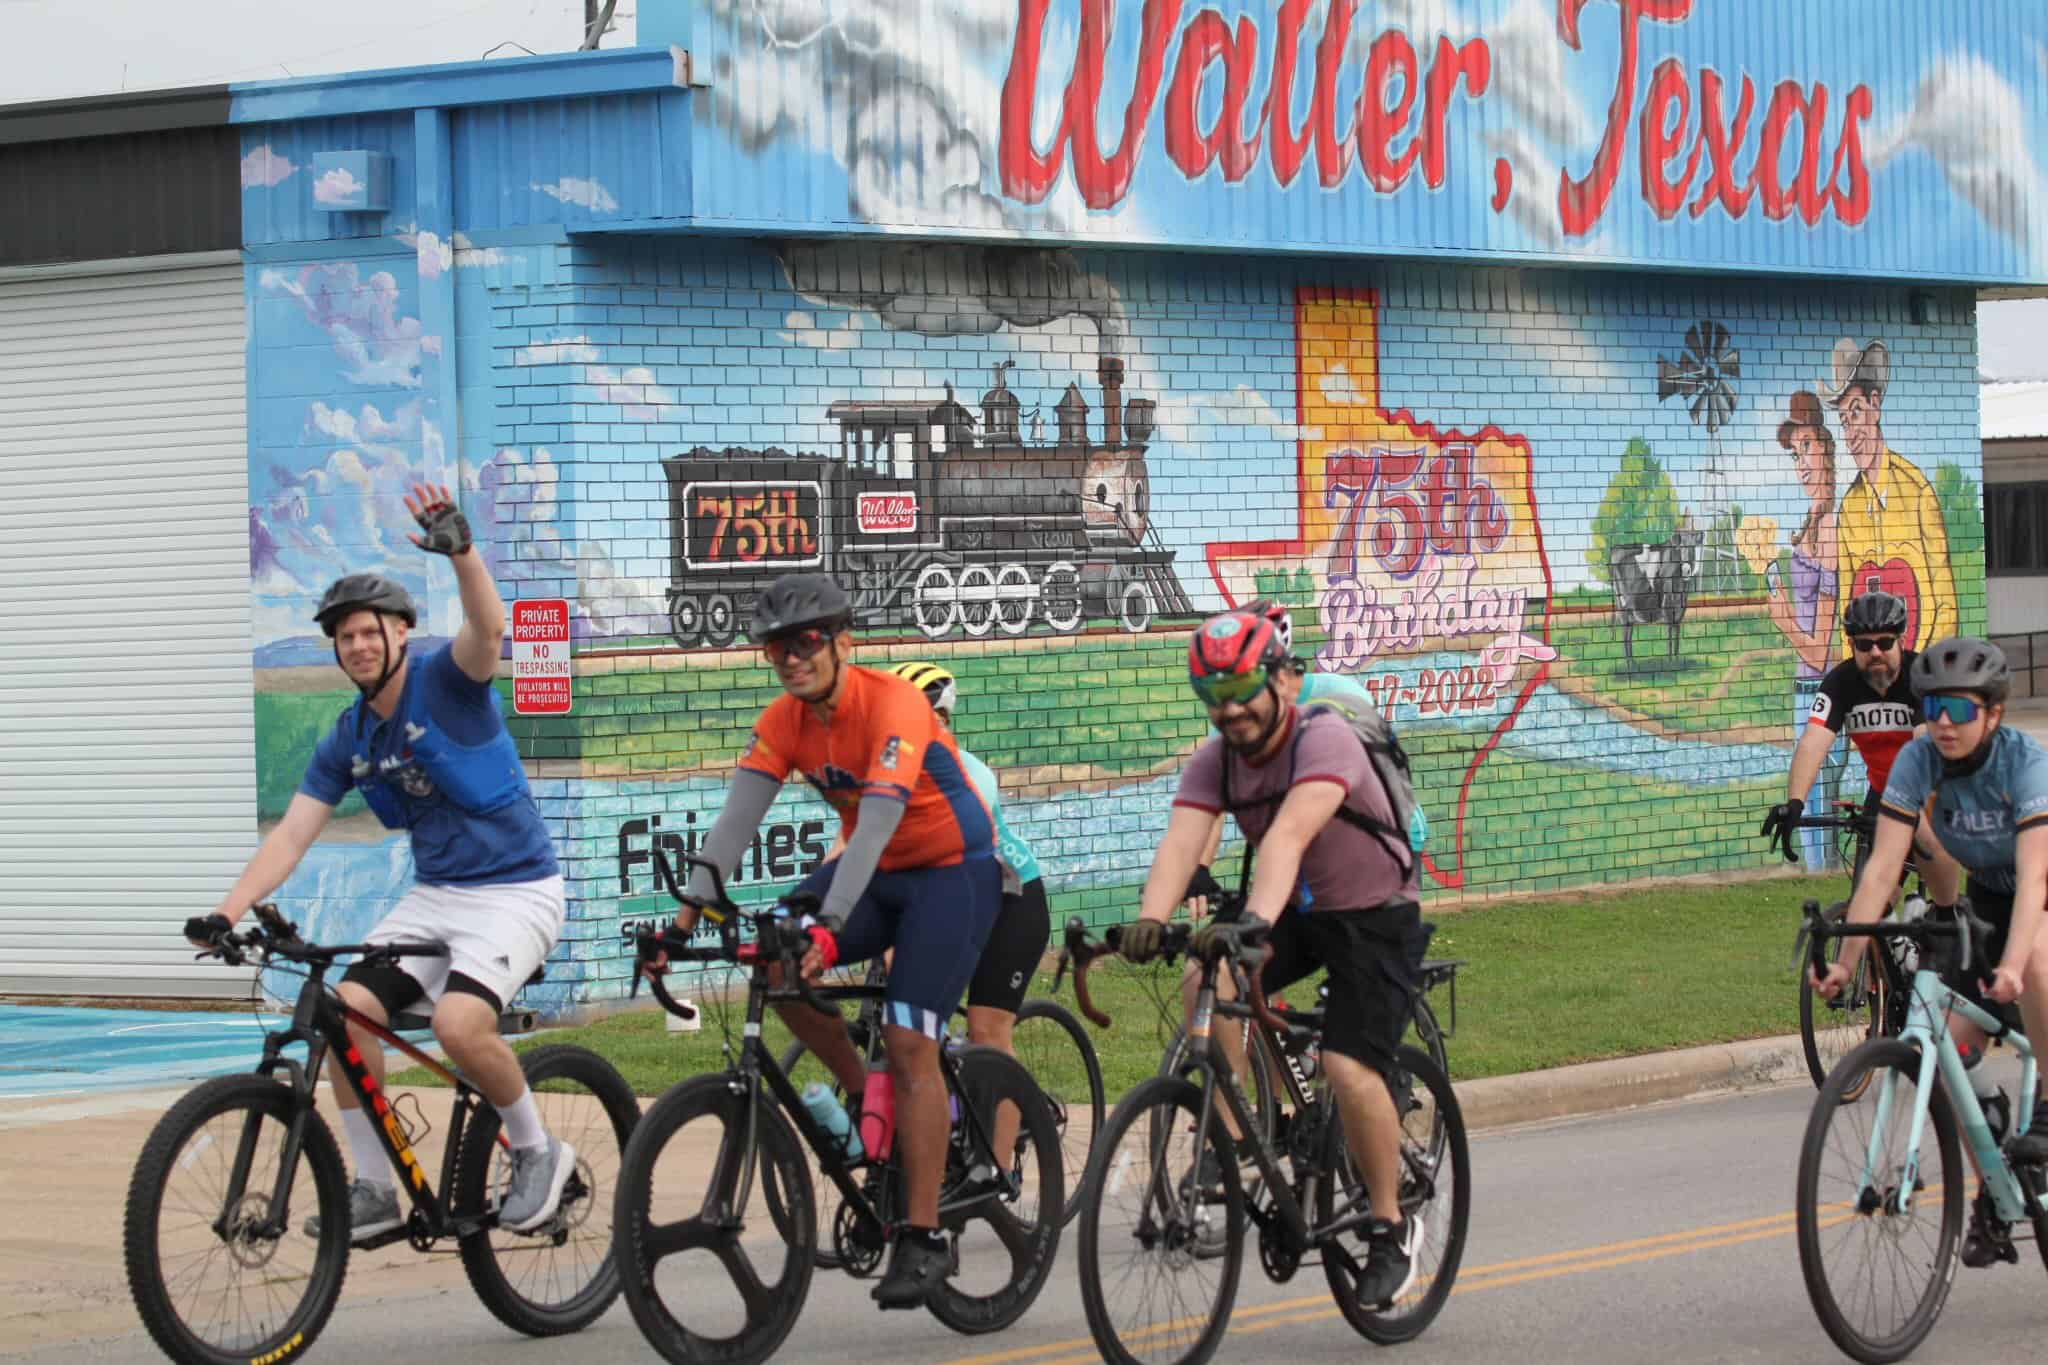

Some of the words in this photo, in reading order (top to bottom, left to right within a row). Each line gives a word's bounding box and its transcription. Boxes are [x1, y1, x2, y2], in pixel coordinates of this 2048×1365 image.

[1558, 0, 1873, 237] Texas
[862, 499, 921, 525] Waller
[1325, 442, 1509, 582] 75th
[697, 490, 817, 562] 75th
[521, 609, 560, 623] PRIVATE
[1316, 553, 1558, 689] Birthday
[516, 624, 565, 638] PROPERTY
[533, 644, 549, 658] NO
[515, 660, 568, 674] TRESPASSING
